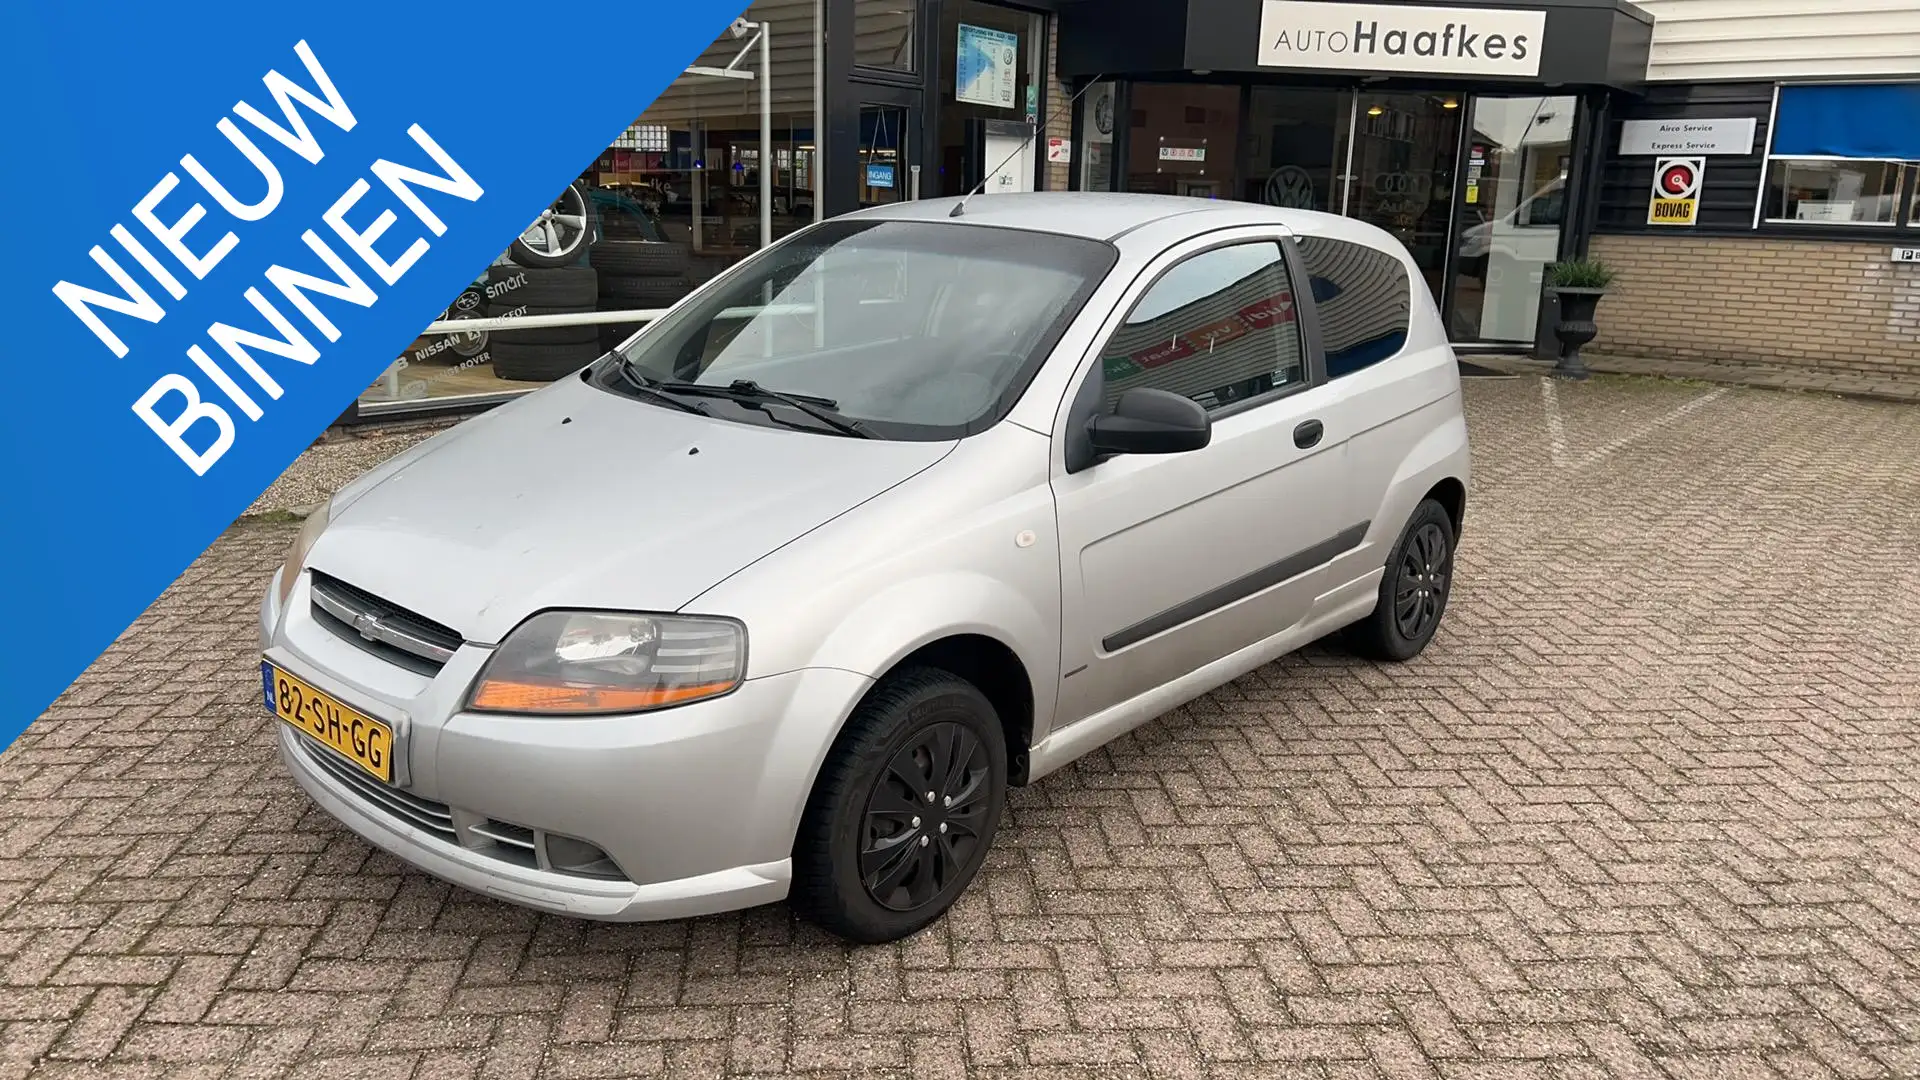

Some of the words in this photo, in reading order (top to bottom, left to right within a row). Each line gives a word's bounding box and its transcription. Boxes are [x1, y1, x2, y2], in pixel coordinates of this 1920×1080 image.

[1660, 124, 1680, 132] Airco
[1684, 124, 1713, 132] Service
[1651, 141, 1682, 150] Express
[1686, 141, 1716, 149] Service
[1654, 202, 1691, 218] BOVAG
[486, 272, 528, 299] smart
[482, 305, 528, 327] EUGEOT
[415, 333, 461, 362] NISSAN
[460, 351, 491, 371] ROVER
[279, 678, 382, 768] 82-SH-GG
